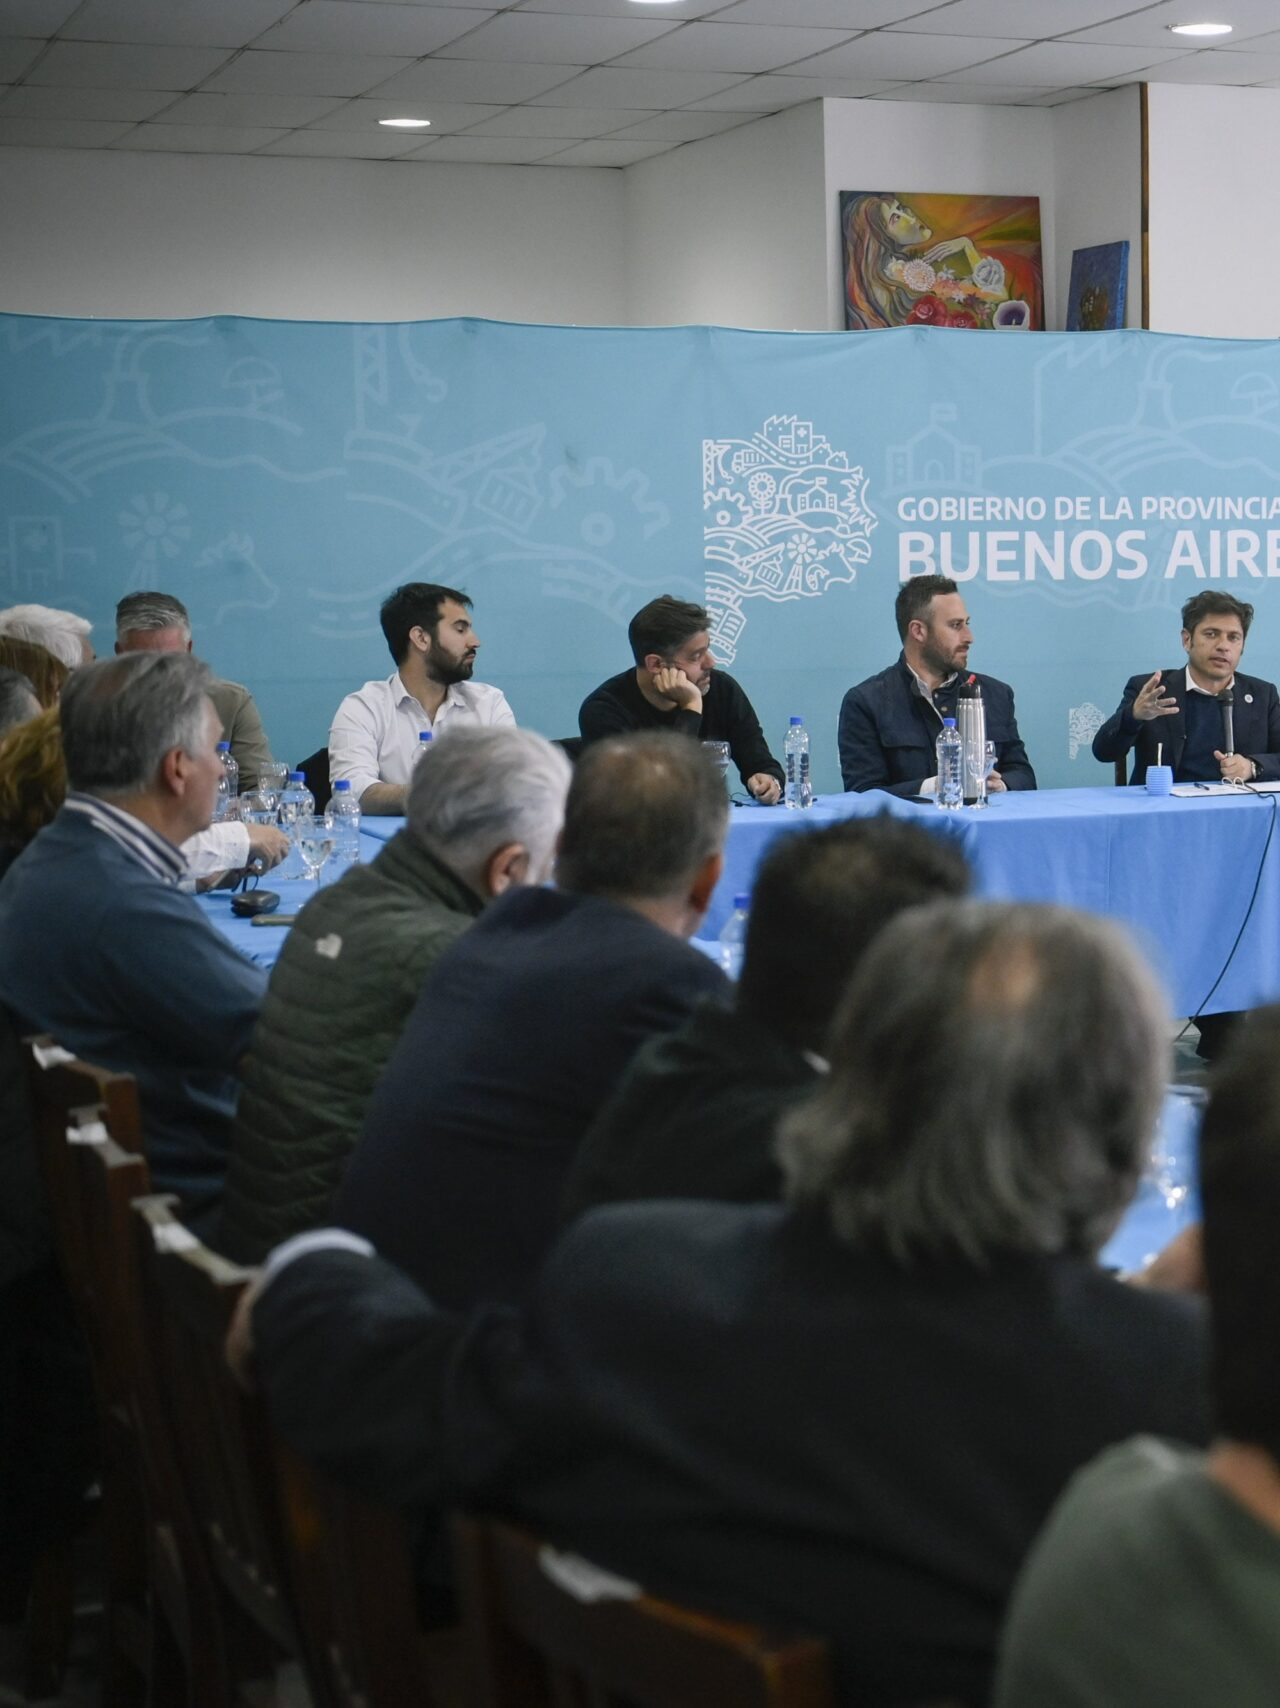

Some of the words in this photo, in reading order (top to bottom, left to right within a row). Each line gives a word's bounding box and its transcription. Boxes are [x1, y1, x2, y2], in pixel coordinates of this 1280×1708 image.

[897, 496, 1047, 522] GOBIERNO
[1054, 496, 1092, 521] DE
[1099, 496, 1135, 521] LA
[898, 529, 1149, 582] BUENOS
